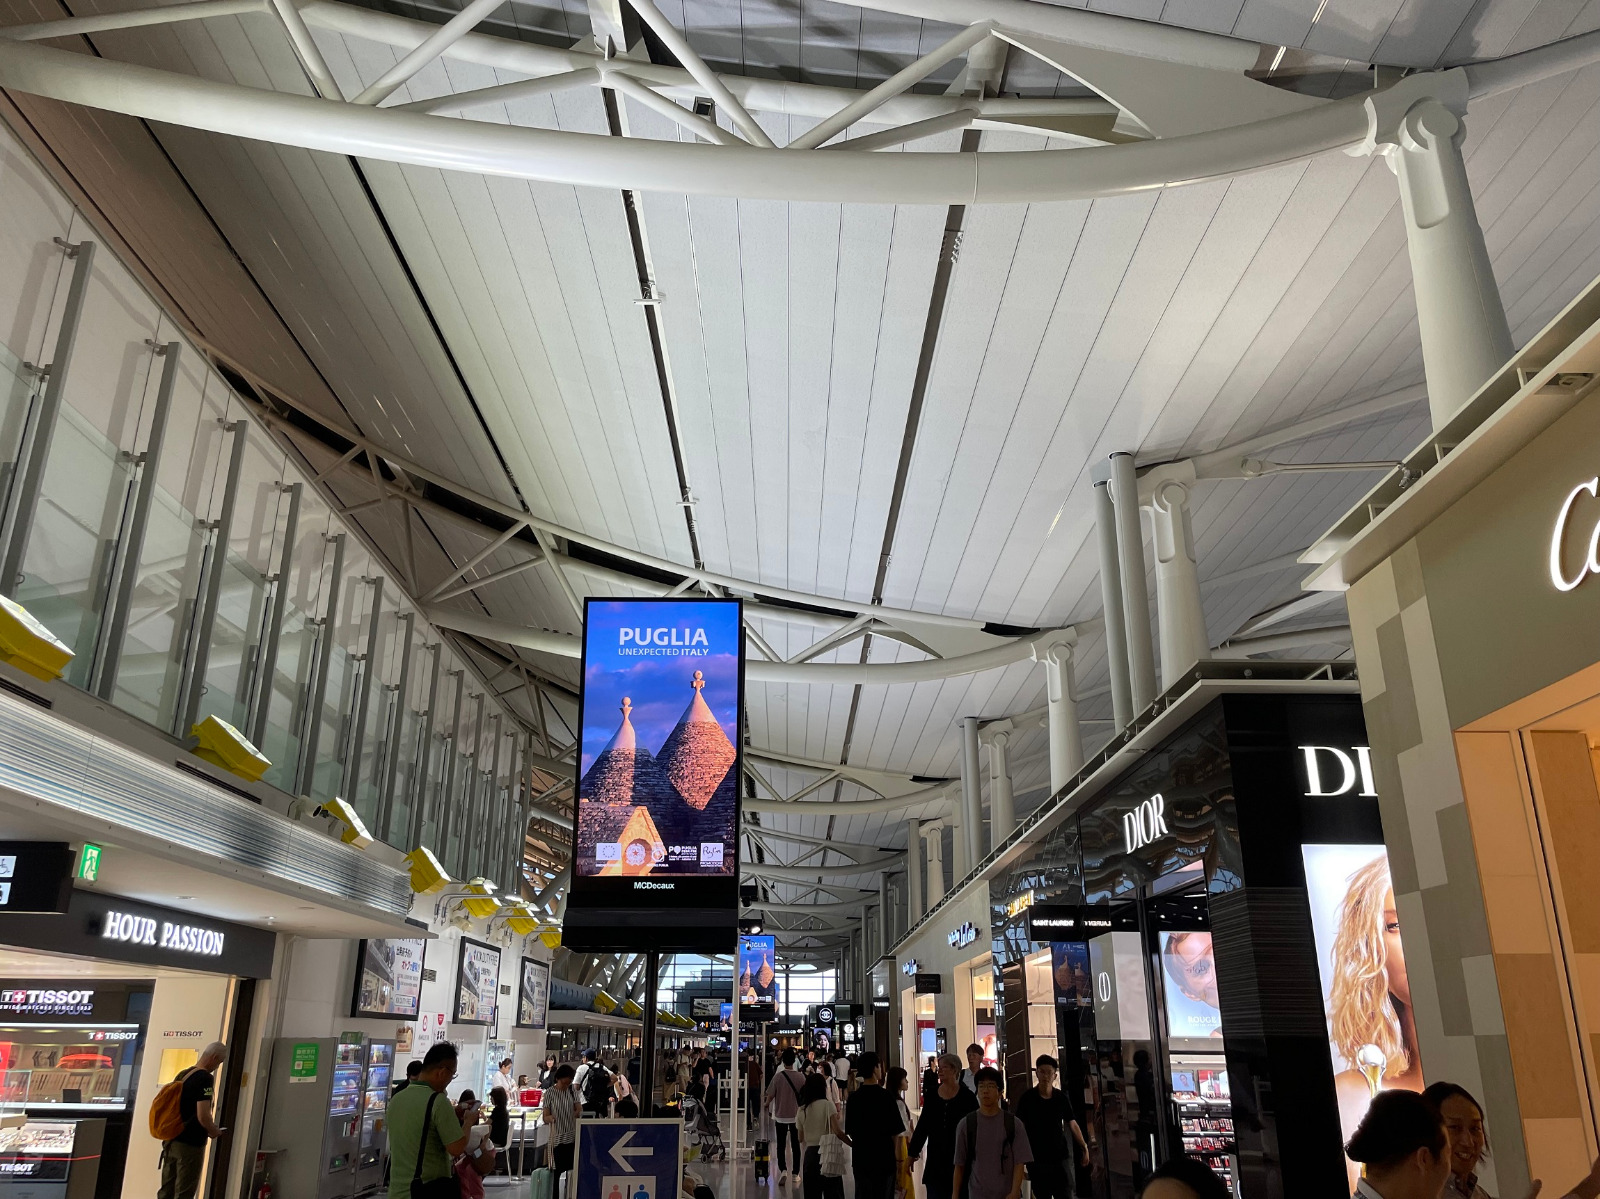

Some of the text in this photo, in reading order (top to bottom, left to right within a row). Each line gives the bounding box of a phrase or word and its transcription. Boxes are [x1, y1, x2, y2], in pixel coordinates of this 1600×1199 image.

[619, 627, 709, 646] PUGLIA
[618, 647, 709, 656] UNEXPECTED ITALY
[1122, 793, 1169, 855] DIOR
[633, 881, 675, 890] MCDecaux
[1032, 919, 1075, 927] SAINT LAURENT
[102, 910, 225, 955] HOUR PASSION
[26, 990, 94, 1004] TISSOT
[104, 1032, 138, 1040] TISSOT
[0, 1163, 35, 1172] TISSOT
